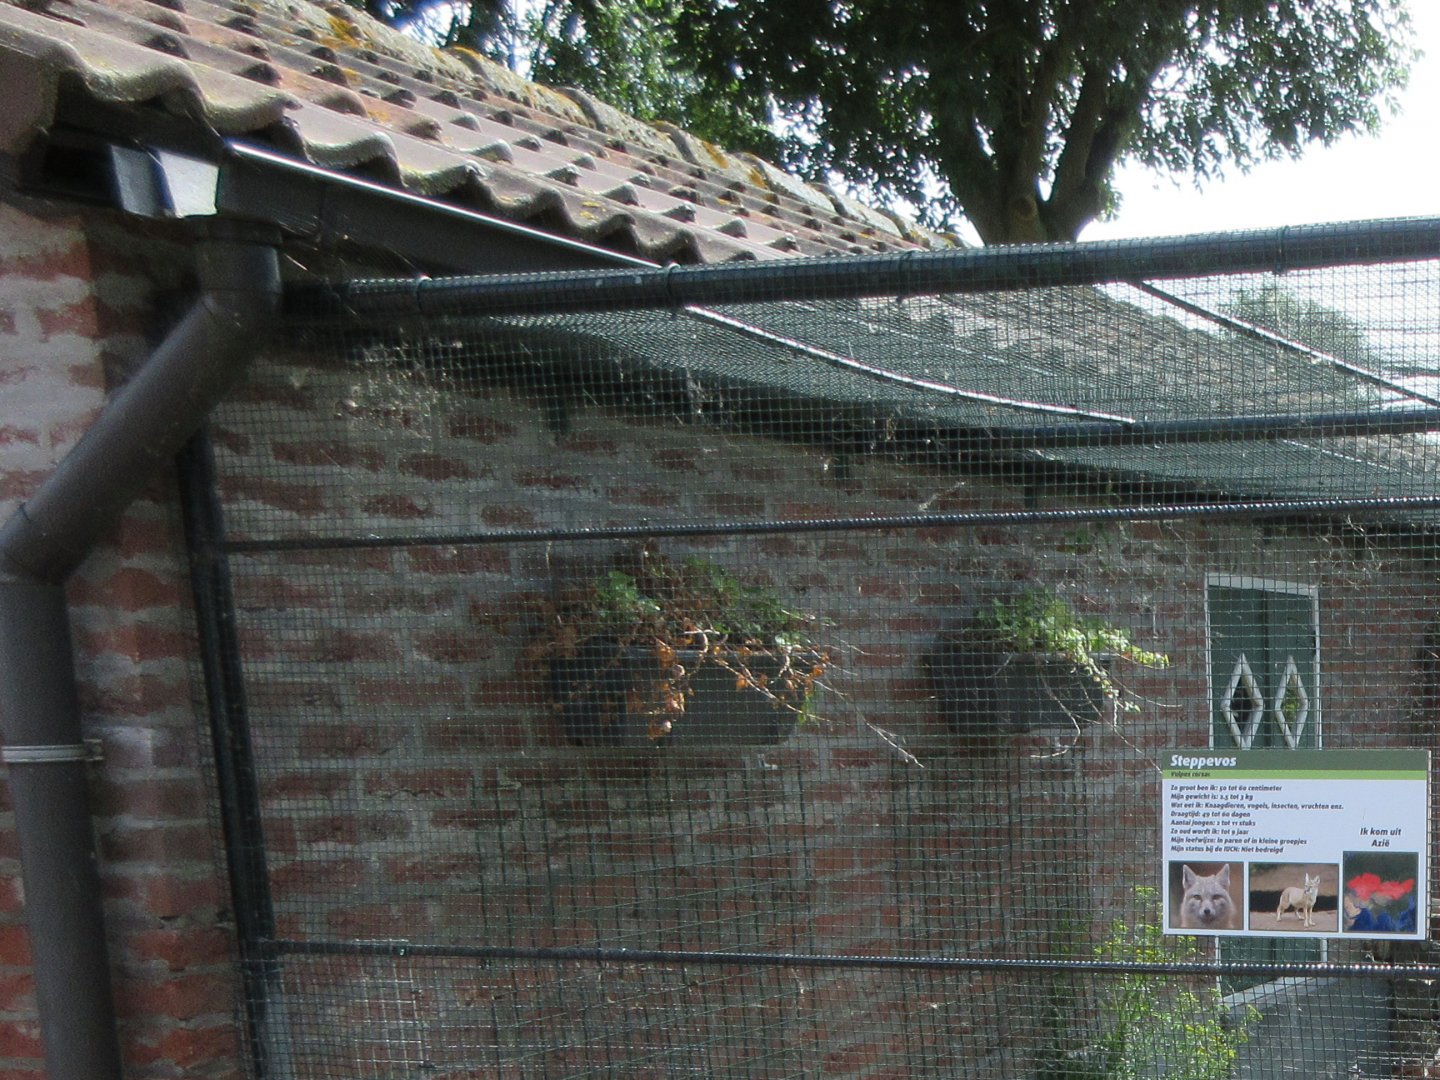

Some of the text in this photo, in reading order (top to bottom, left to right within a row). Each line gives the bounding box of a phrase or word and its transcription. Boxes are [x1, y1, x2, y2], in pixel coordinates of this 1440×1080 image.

[1170, 754, 1237, 769] Steppevos
[1179, 785, 1196, 793] groot
[1170, 793, 1184, 801] Mijn
[1185, 793, 1210, 801] gewicht
[1245, 793, 1254, 801] kg
[1204, 802, 1246, 810] Knaagdieren,
[1247, 802, 1269, 810] vogels,
[1271, 802, 1300, 810] insecten,
[1170, 810, 1201, 818] Draagtijd:
[1360, 827, 1402, 836] Ik kom uit
[1279, 838, 1307, 846] groepjes
[1371, 838, 1390, 847] Azië
[1205, 845, 1213, 853] bij
[1255, 846, 1284, 854] bedreigd
